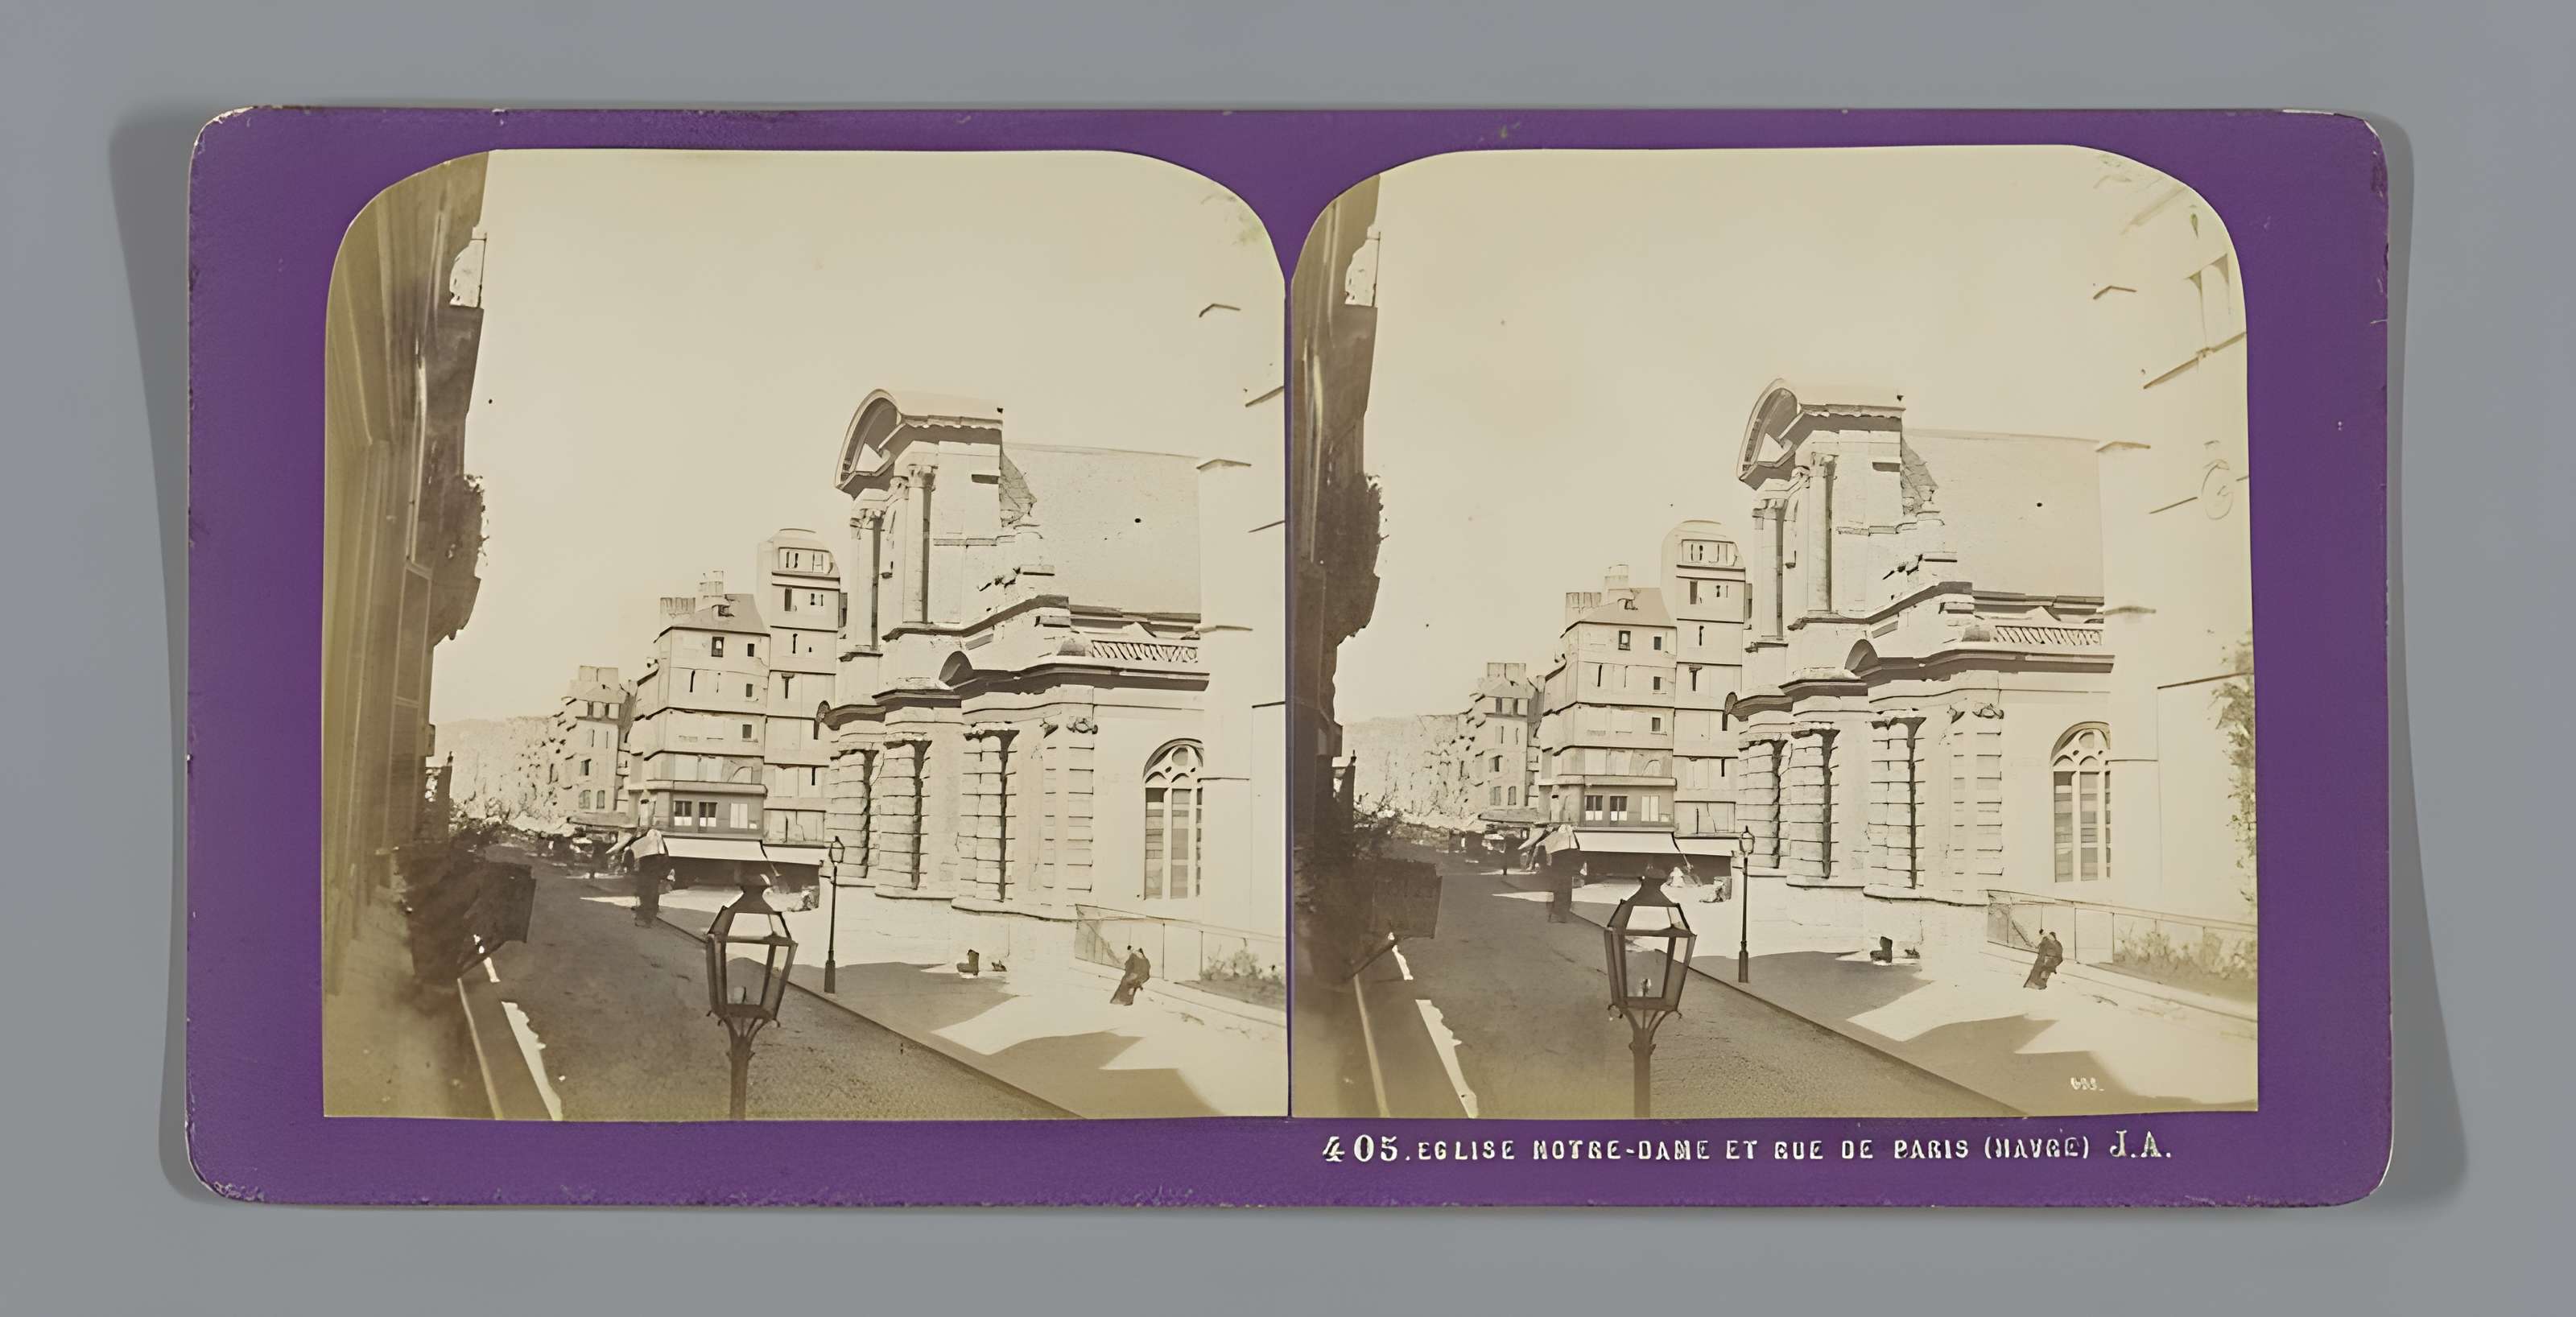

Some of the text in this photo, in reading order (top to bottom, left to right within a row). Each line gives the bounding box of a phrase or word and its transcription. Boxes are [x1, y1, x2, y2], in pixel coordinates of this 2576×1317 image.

[1725, 1140, 1758, 1160] ET
[1774, 1140, 1823, 1160] RUE
[1841, 1140, 1873, 1160] DE
[1893, 1139, 1969, 1159] PARIS
[1984, 1136, 2089, 1159] (HAVRE)
[2109, 1129, 2171, 1158] J.A.
